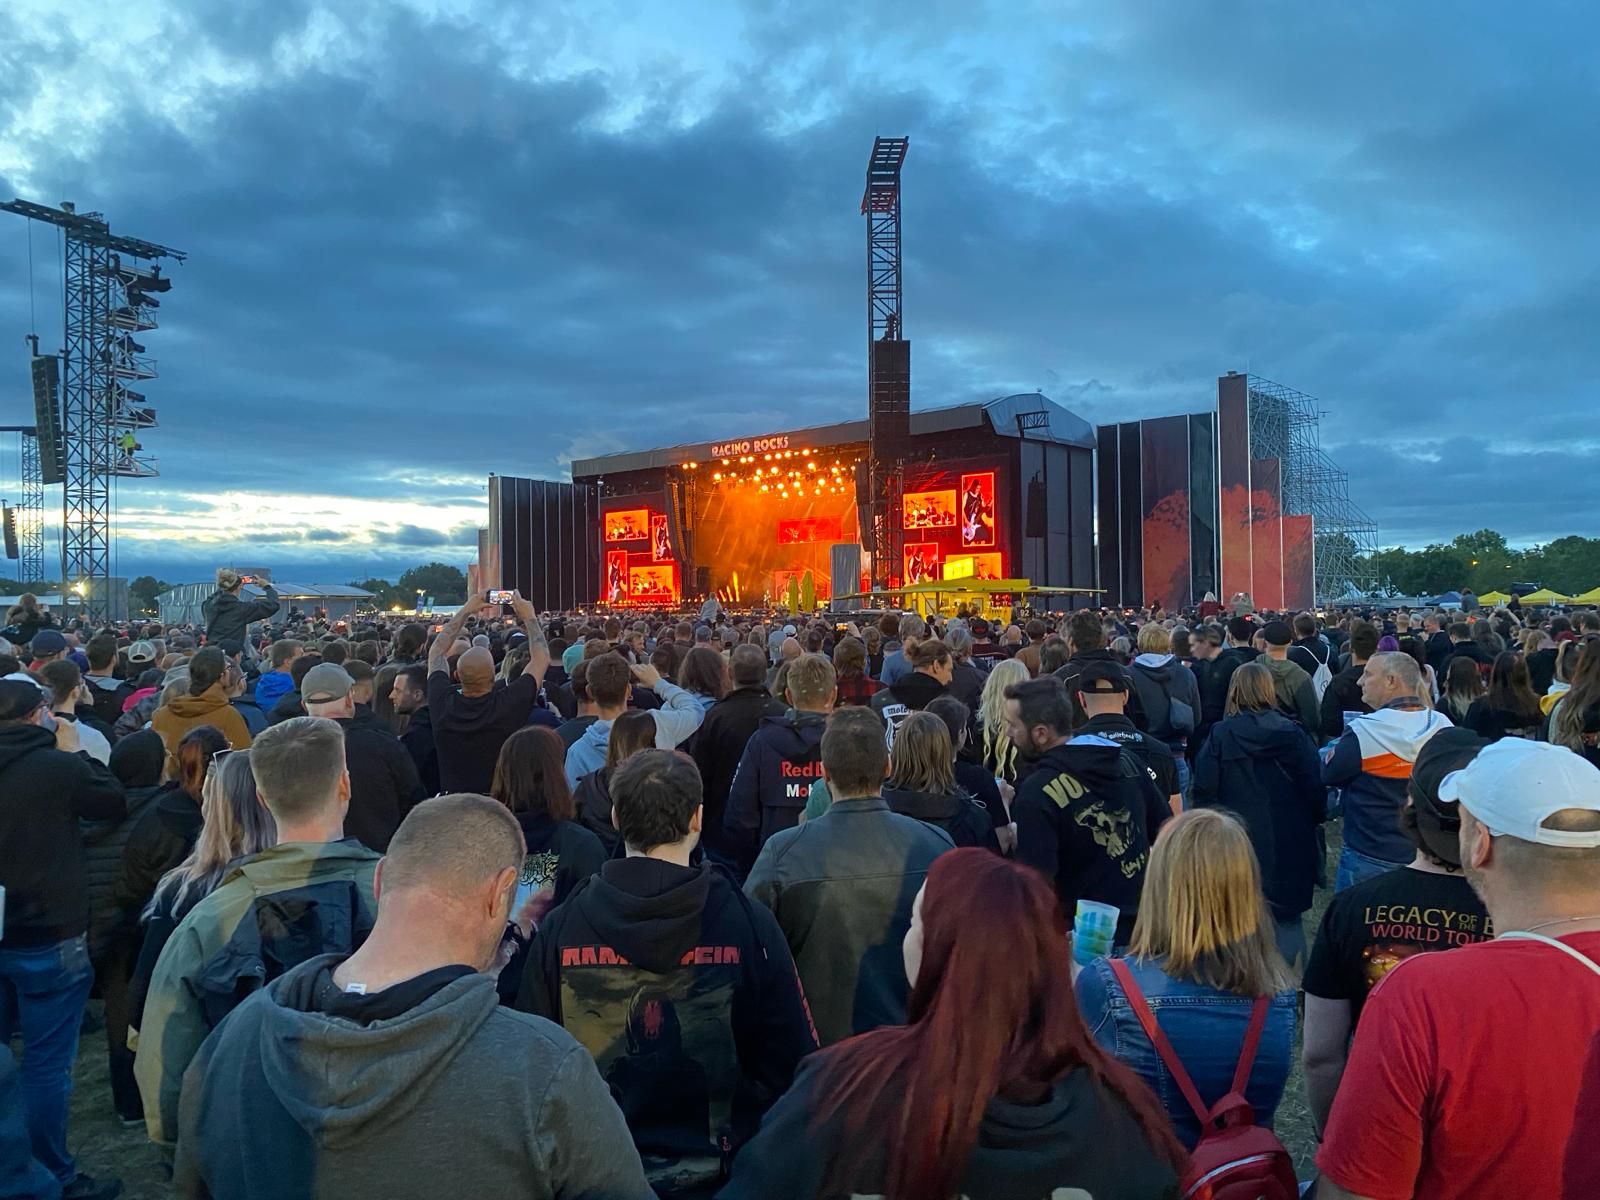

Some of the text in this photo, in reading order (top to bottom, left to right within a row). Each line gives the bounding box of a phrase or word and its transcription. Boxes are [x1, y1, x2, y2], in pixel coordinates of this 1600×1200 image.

[753, 436, 789, 453] ROCKS
[781, 761, 813, 777] Red
[1364, 905, 1478, 928] LEGACY OF
[1371, 924, 1440, 943] WORLD
